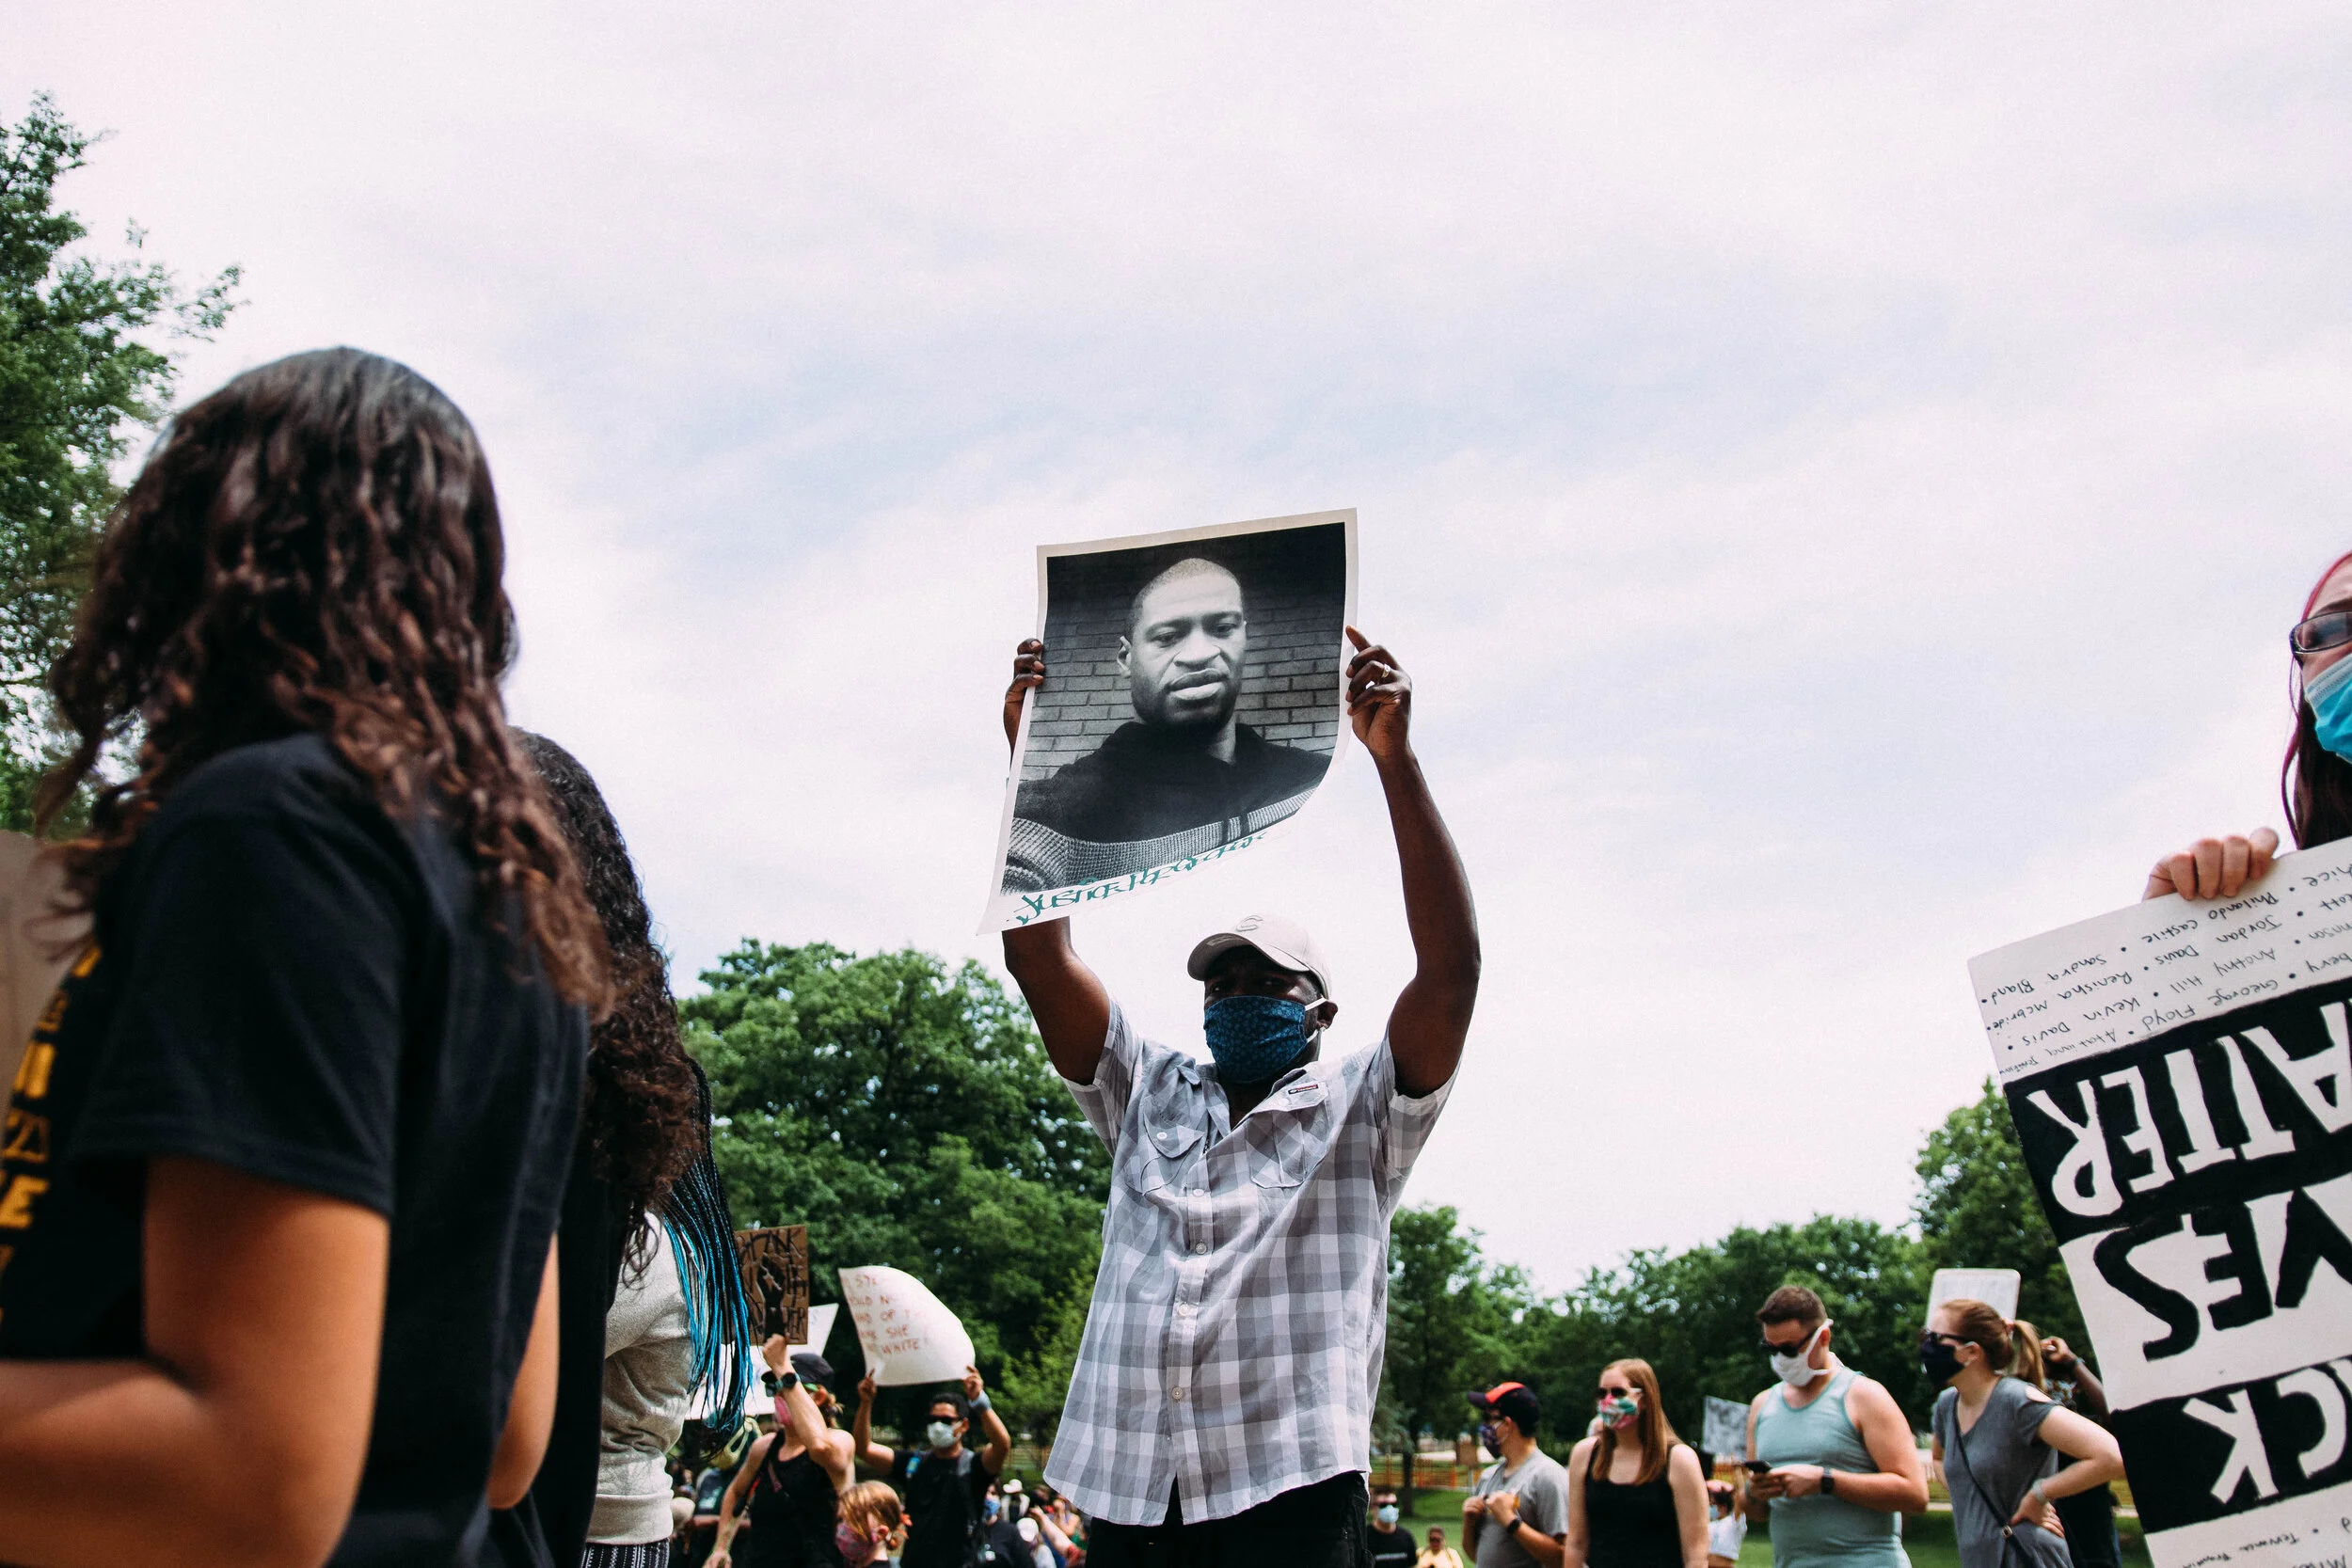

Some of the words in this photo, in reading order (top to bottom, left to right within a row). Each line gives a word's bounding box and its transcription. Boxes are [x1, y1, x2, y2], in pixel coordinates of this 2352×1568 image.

[2208, 892, 2279, 919] Philando
[2216, 915, 2282, 943] Jordan
[2047, 955, 2106, 981] Sandra
[2154, 945, 2199, 965] Davis
[1992, 978, 2035, 1005] Bland
[2057, 972, 2132, 1000] Renisha
[2169, 975, 2202, 993] Hill
[2207, 979, 2279, 1006] George
[2083, 996, 2140, 1021] Kevin
[2142, 1005, 2196, 1031] Floyd
[2022, 1022, 2070, 1046] Davis
[2026, 1000, 2352, 1216] ATTER
[2182, 1361, 2352, 1504] CK
